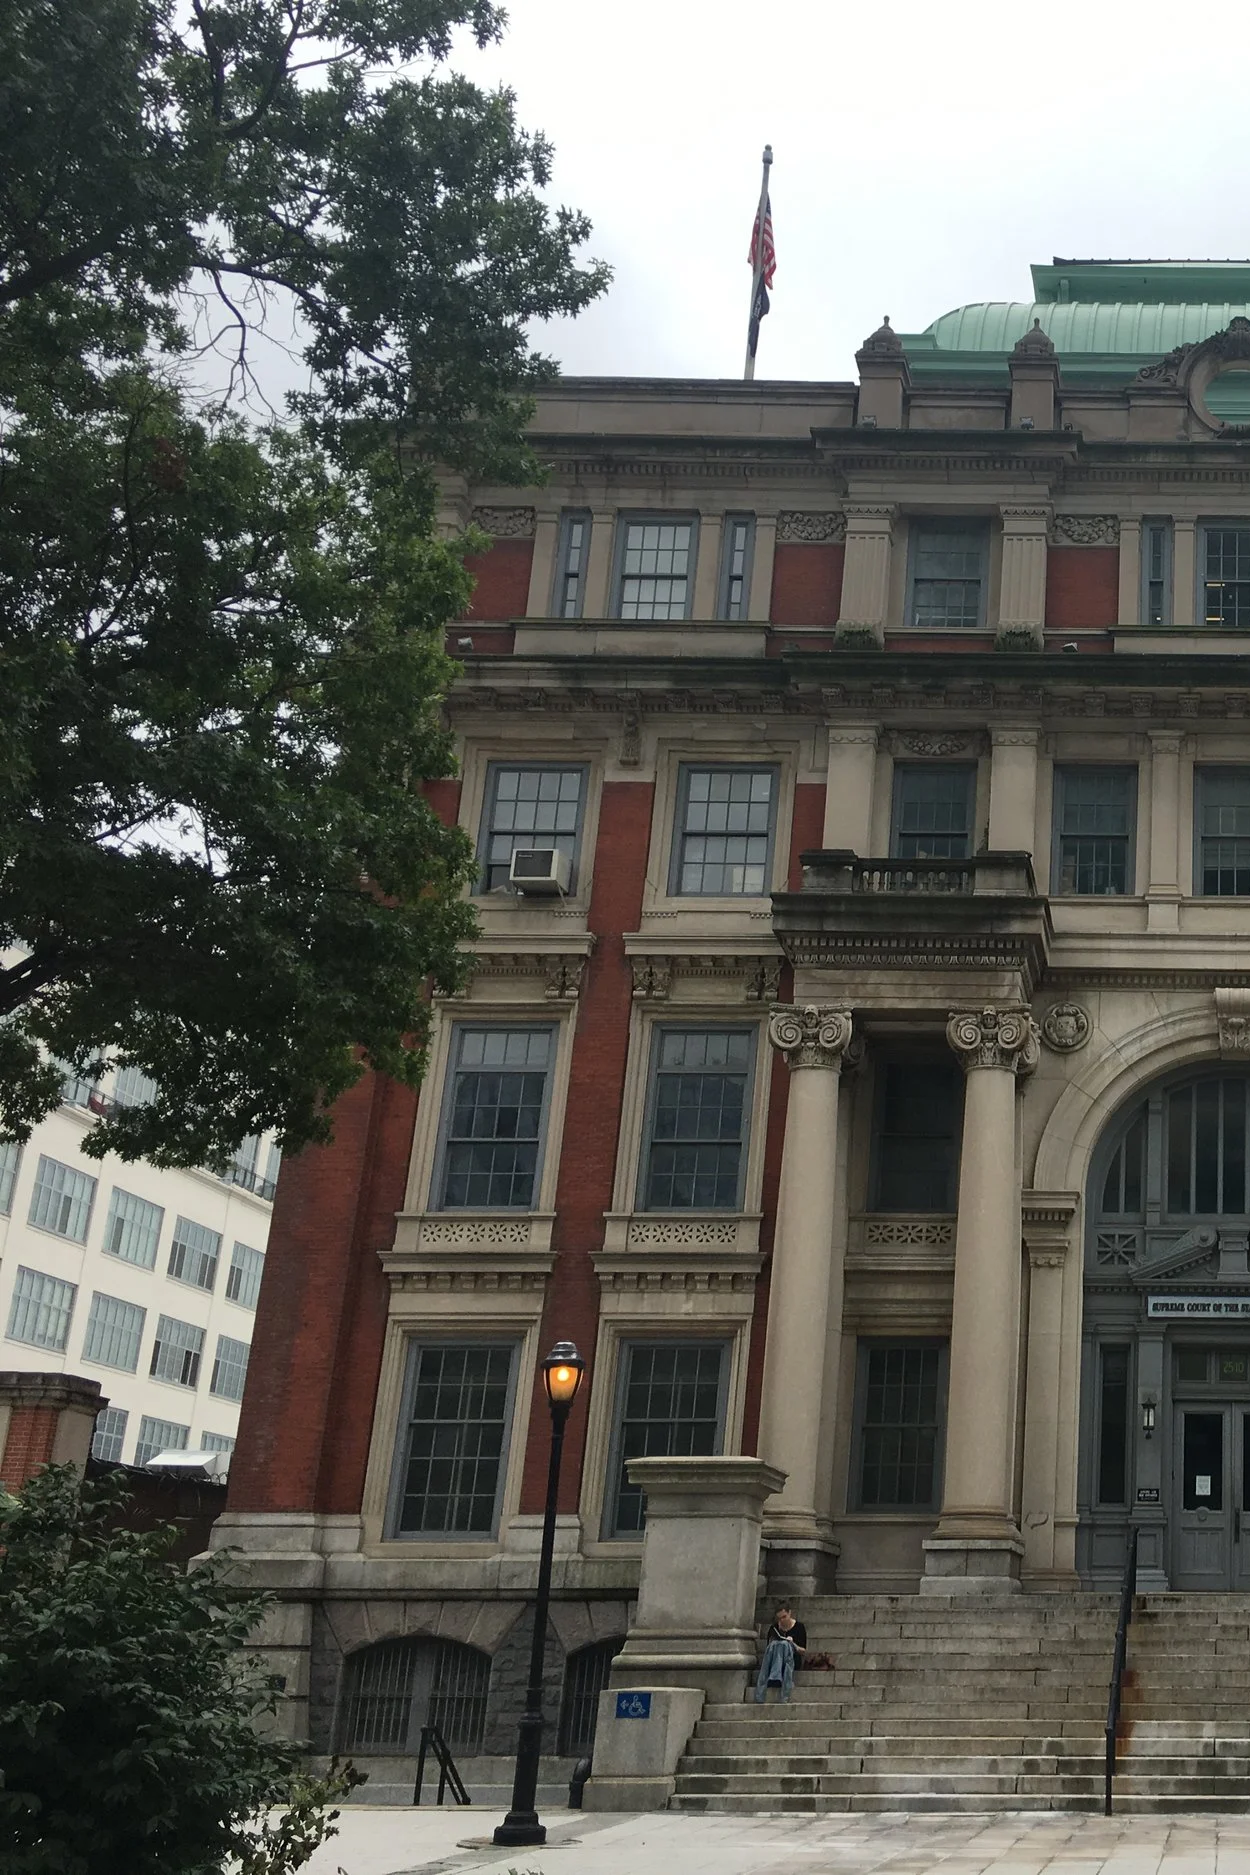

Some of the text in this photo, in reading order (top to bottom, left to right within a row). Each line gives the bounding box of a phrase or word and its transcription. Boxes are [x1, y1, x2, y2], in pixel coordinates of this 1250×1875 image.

[1152, 1302, 1186, 1312] SUPREME
[1187, 1303, 1212, 1312] COURT
[1212, 1303, 1222, 1313] OF
[1223, 1303, 1239, 1313] THE
